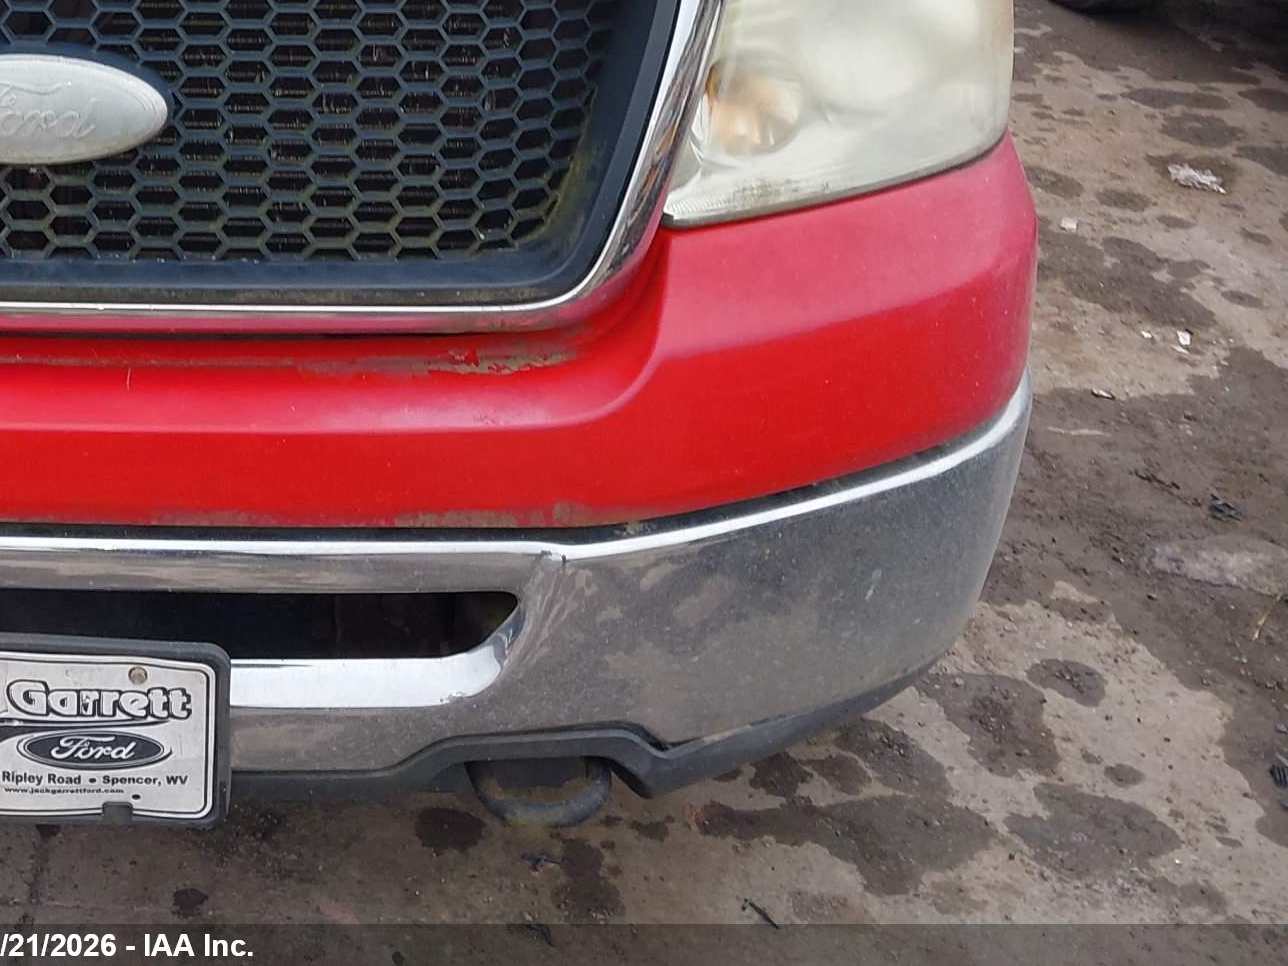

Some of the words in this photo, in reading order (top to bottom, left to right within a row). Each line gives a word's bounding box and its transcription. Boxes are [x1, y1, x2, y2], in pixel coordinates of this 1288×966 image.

[6, 679, 193, 721] Garrett
[50, 735, 137, 761] Ford
[2, 770, 43, 787] Ripley
[47, 773, 82, 786] Road
[102, 773, 162, 788] Spencer,
[165, 775, 189, 786] WV
